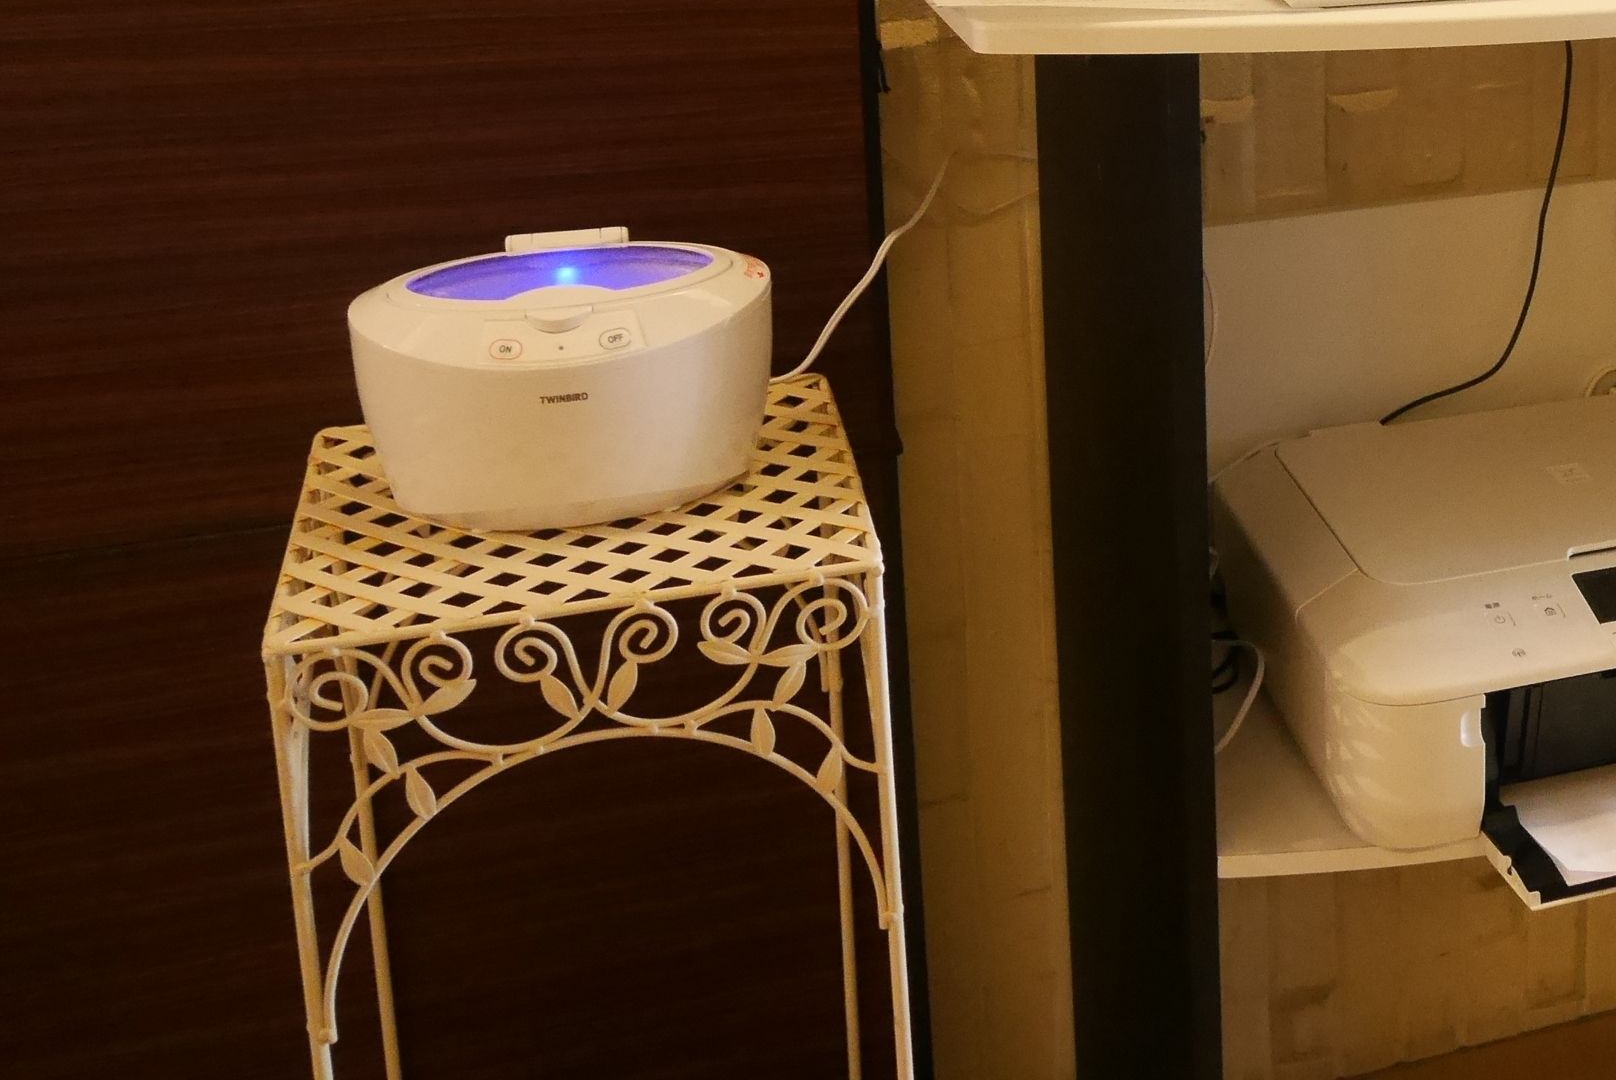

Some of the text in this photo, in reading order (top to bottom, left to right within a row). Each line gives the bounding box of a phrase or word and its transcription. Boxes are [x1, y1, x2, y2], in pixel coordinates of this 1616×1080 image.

[607, 333, 624, 344] OFF
[499, 345, 512, 354] ON
[540, 392, 588, 405] TWINBIRD
